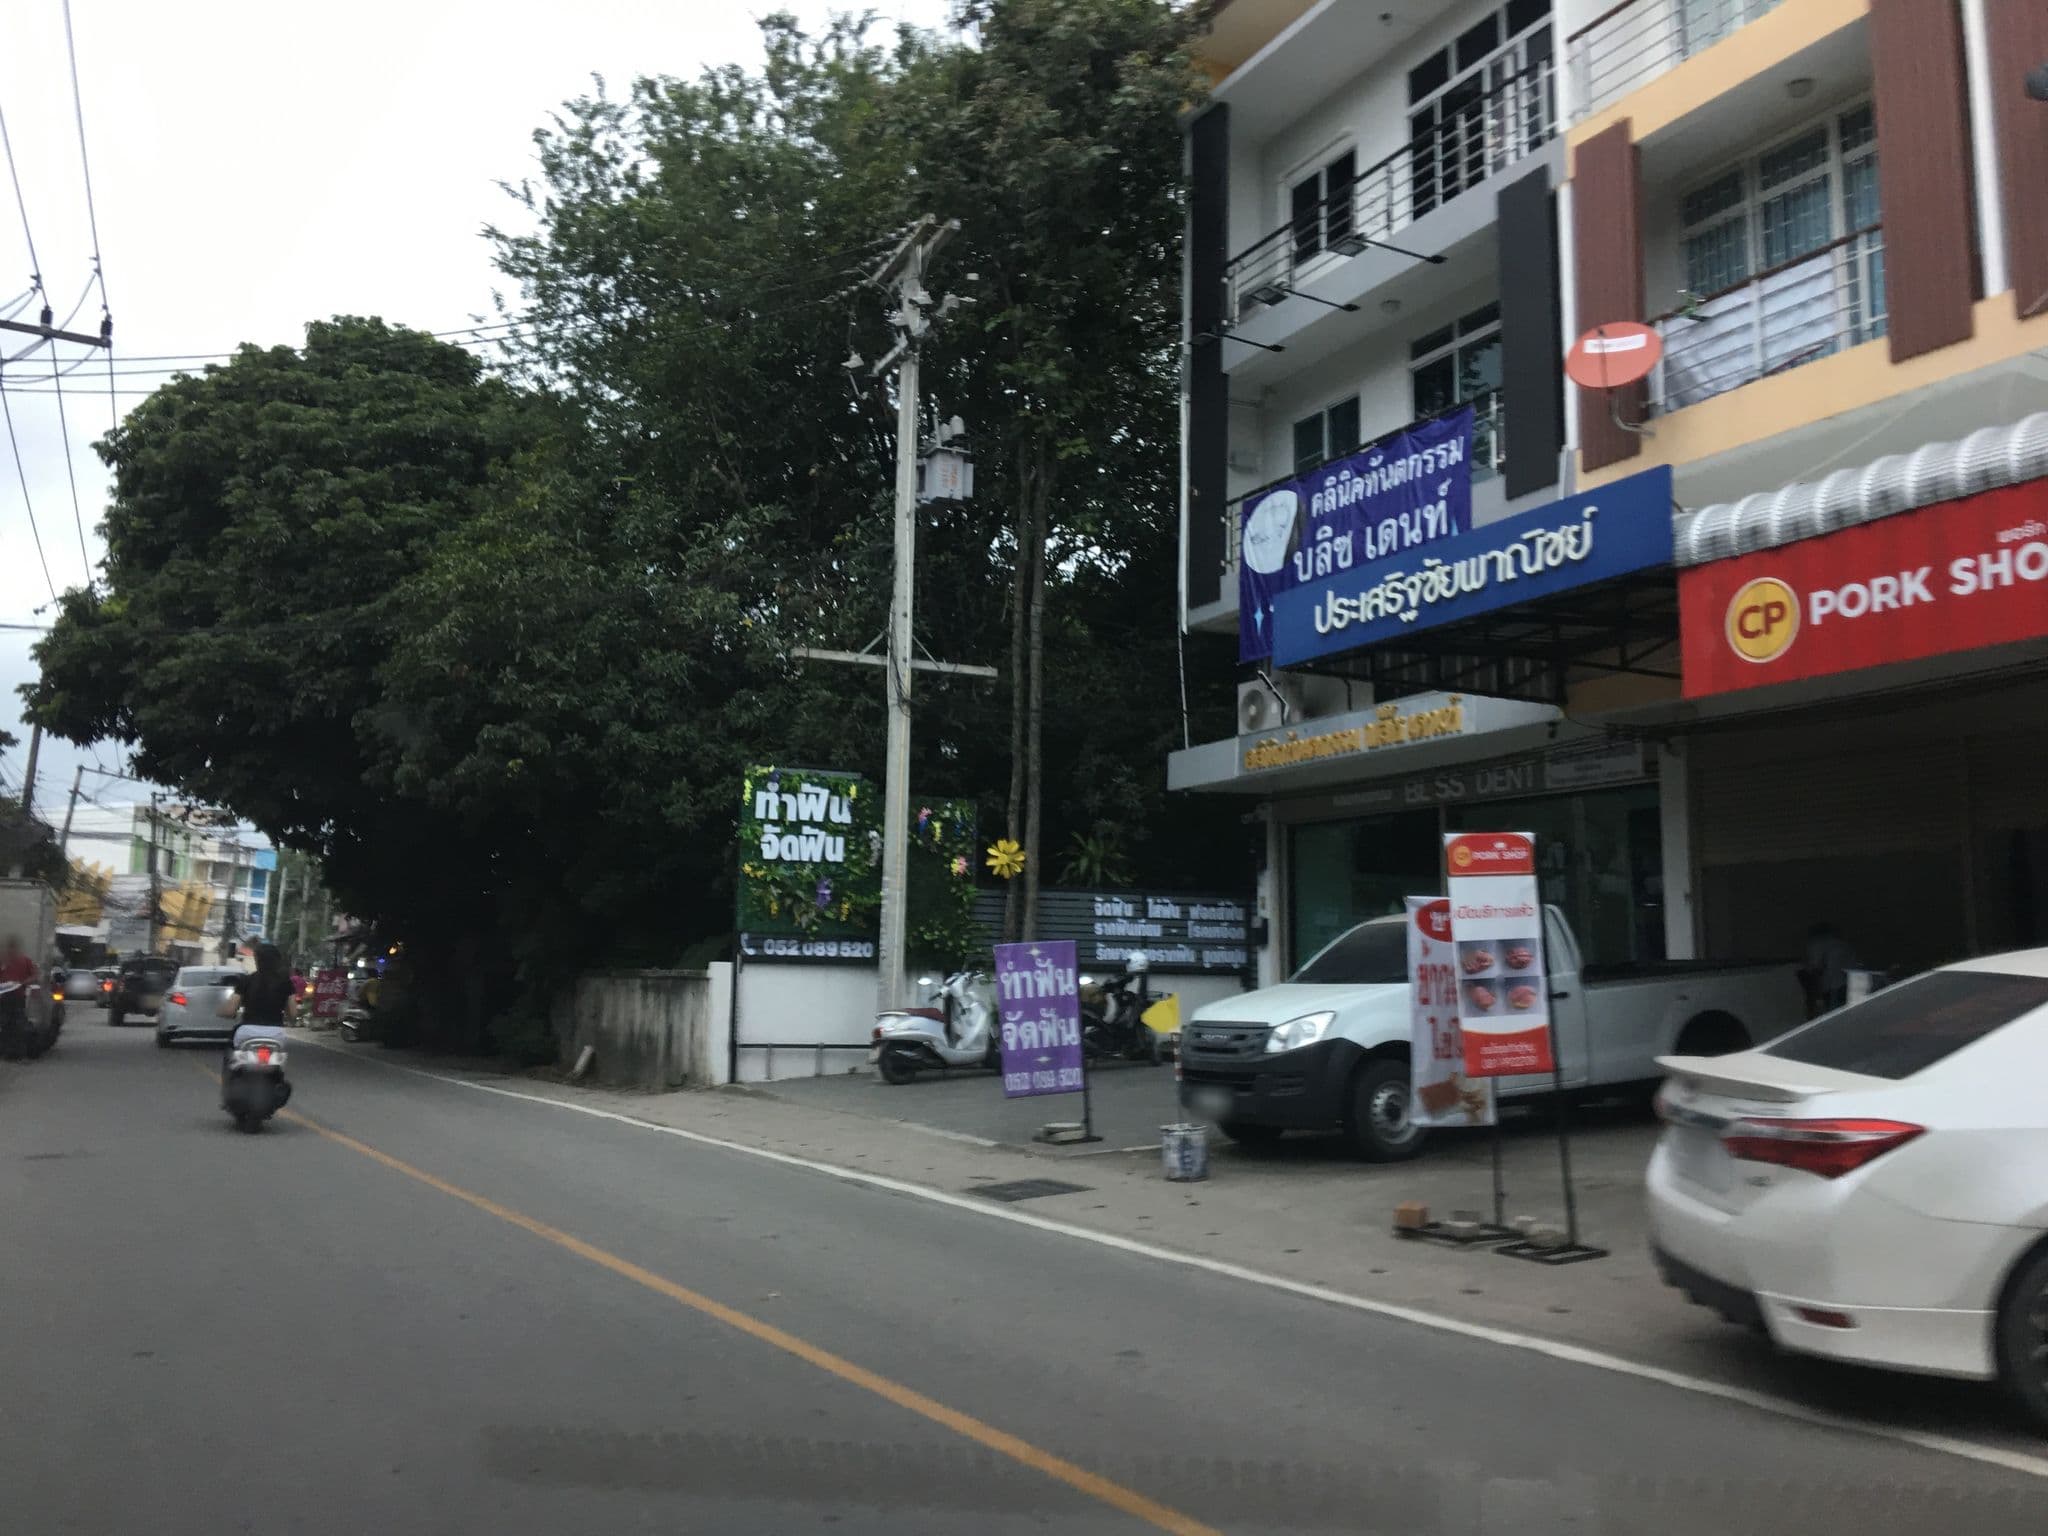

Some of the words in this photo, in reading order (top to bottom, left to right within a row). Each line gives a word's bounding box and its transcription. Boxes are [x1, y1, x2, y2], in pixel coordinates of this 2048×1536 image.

[1365, 477, 1452, 560] เดนท์
[1315, 506, 1598, 634] ประเสริฐชัยพาณิชย์
[1737, 600, 1786, 639] CP
[1809, 566, 1934, 625] PORK
[755, 781, 851, 824] ทำฟัน
[761, 824, 844, 862] จัดฟัน
[1000, 958, 1077, 999] ทำฟัน
[1002, 1007, 1081, 1051] จัดฟัน
